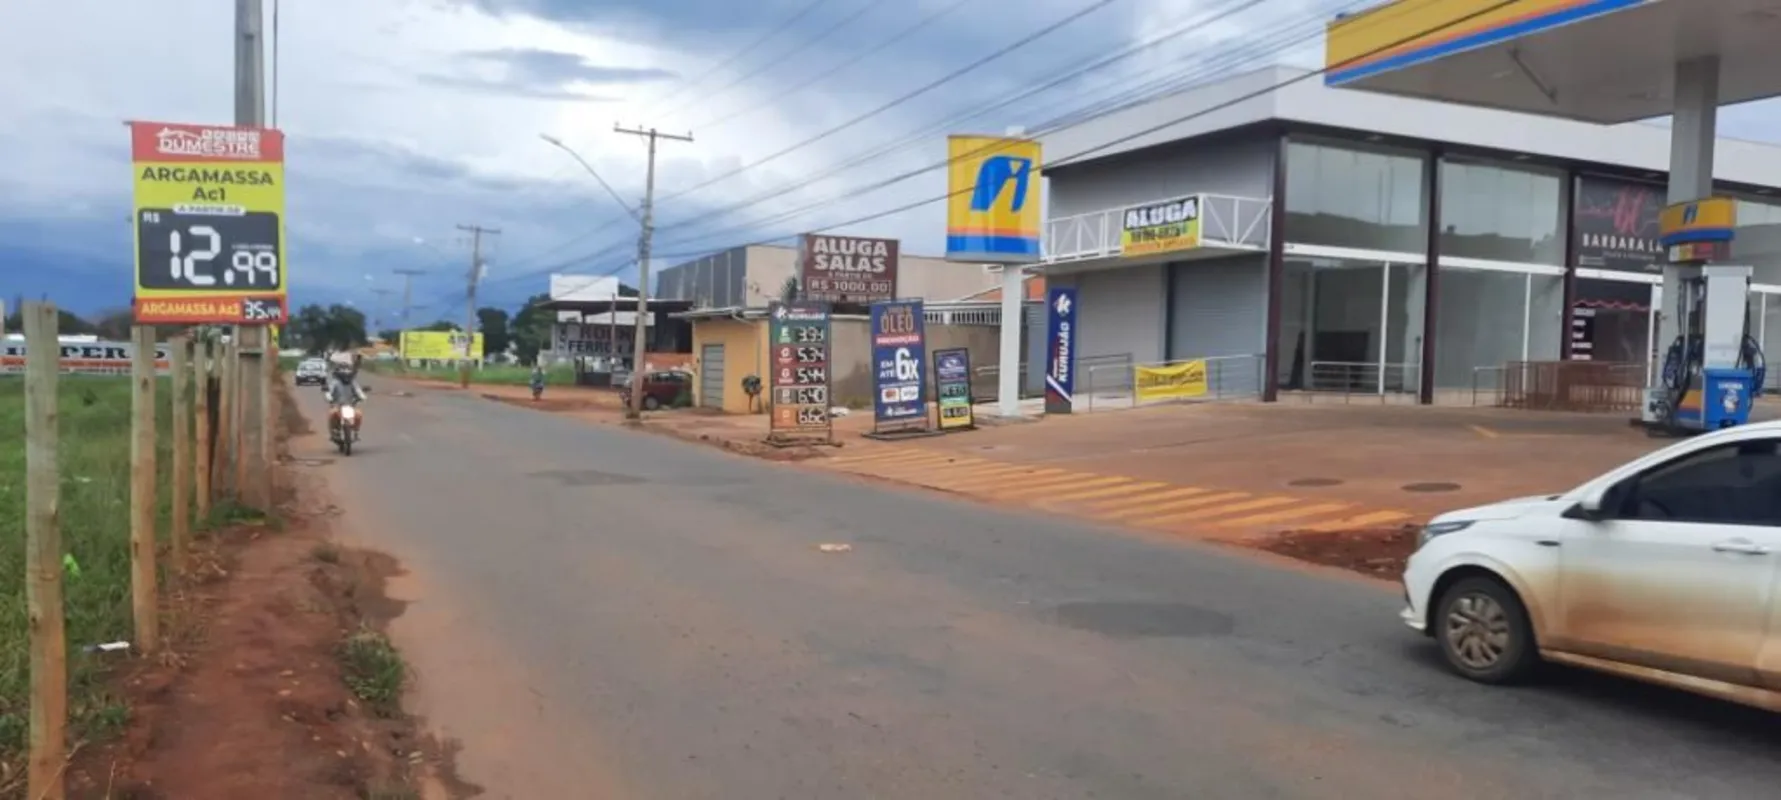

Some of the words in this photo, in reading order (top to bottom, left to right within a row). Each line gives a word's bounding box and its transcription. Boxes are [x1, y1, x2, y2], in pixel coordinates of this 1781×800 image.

[141, 166, 274, 186] ARGAMASSA
[192, 186, 227, 202] Ac1
[1126, 198, 1197, 229] ALUGA
[812, 237, 889, 257] ALUGA
[813, 253, 887, 274] SALAS
[140, 302, 216, 316] ARGAMASSA
[880, 360, 894, 369] EM
